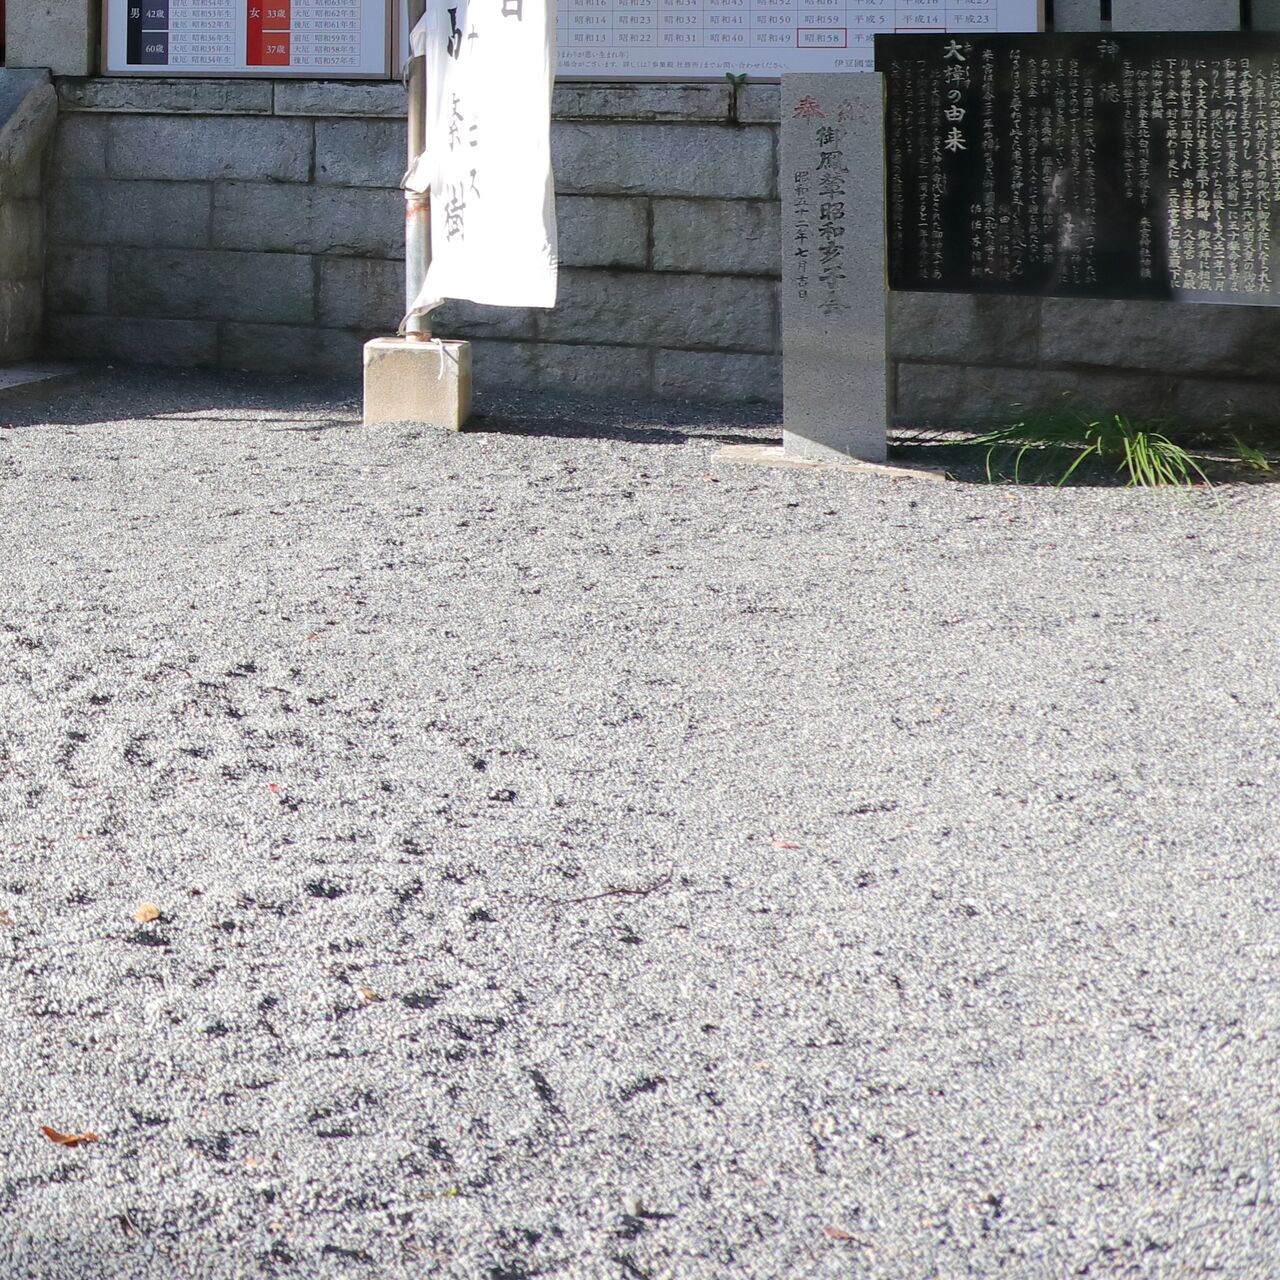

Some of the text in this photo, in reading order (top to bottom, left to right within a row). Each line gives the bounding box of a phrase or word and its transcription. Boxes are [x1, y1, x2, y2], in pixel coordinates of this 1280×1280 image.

[130, 8, 140, 18] 男
[146, 10, 165, 18] 42歳
[249, 8, 260, 18] 女
[267, 10, 286, 18] 33歳
[575, 15, 989, 24] 昭和14 昭和23 昭和32 昭和41 昭和50 昭和59 平成5 平成14 平成23
[575, 34, 606, 42] 昭和13
[619, 34, 651, 42] 昭和22
[664, 34, 697, 42] 昭和31
[710, 34, 744, 42] 昭和40
[757, 34, 790, 42] 昭和49
[804, 34, 839, 42] 昭和58
[145, 45, 164, 53] 60歳
[266, 45, 286, 54] 37歳
[943, 39, 967, 153] 大樟の由来
[794, 171, 809, 299] 昭和五十二年七月吉日
